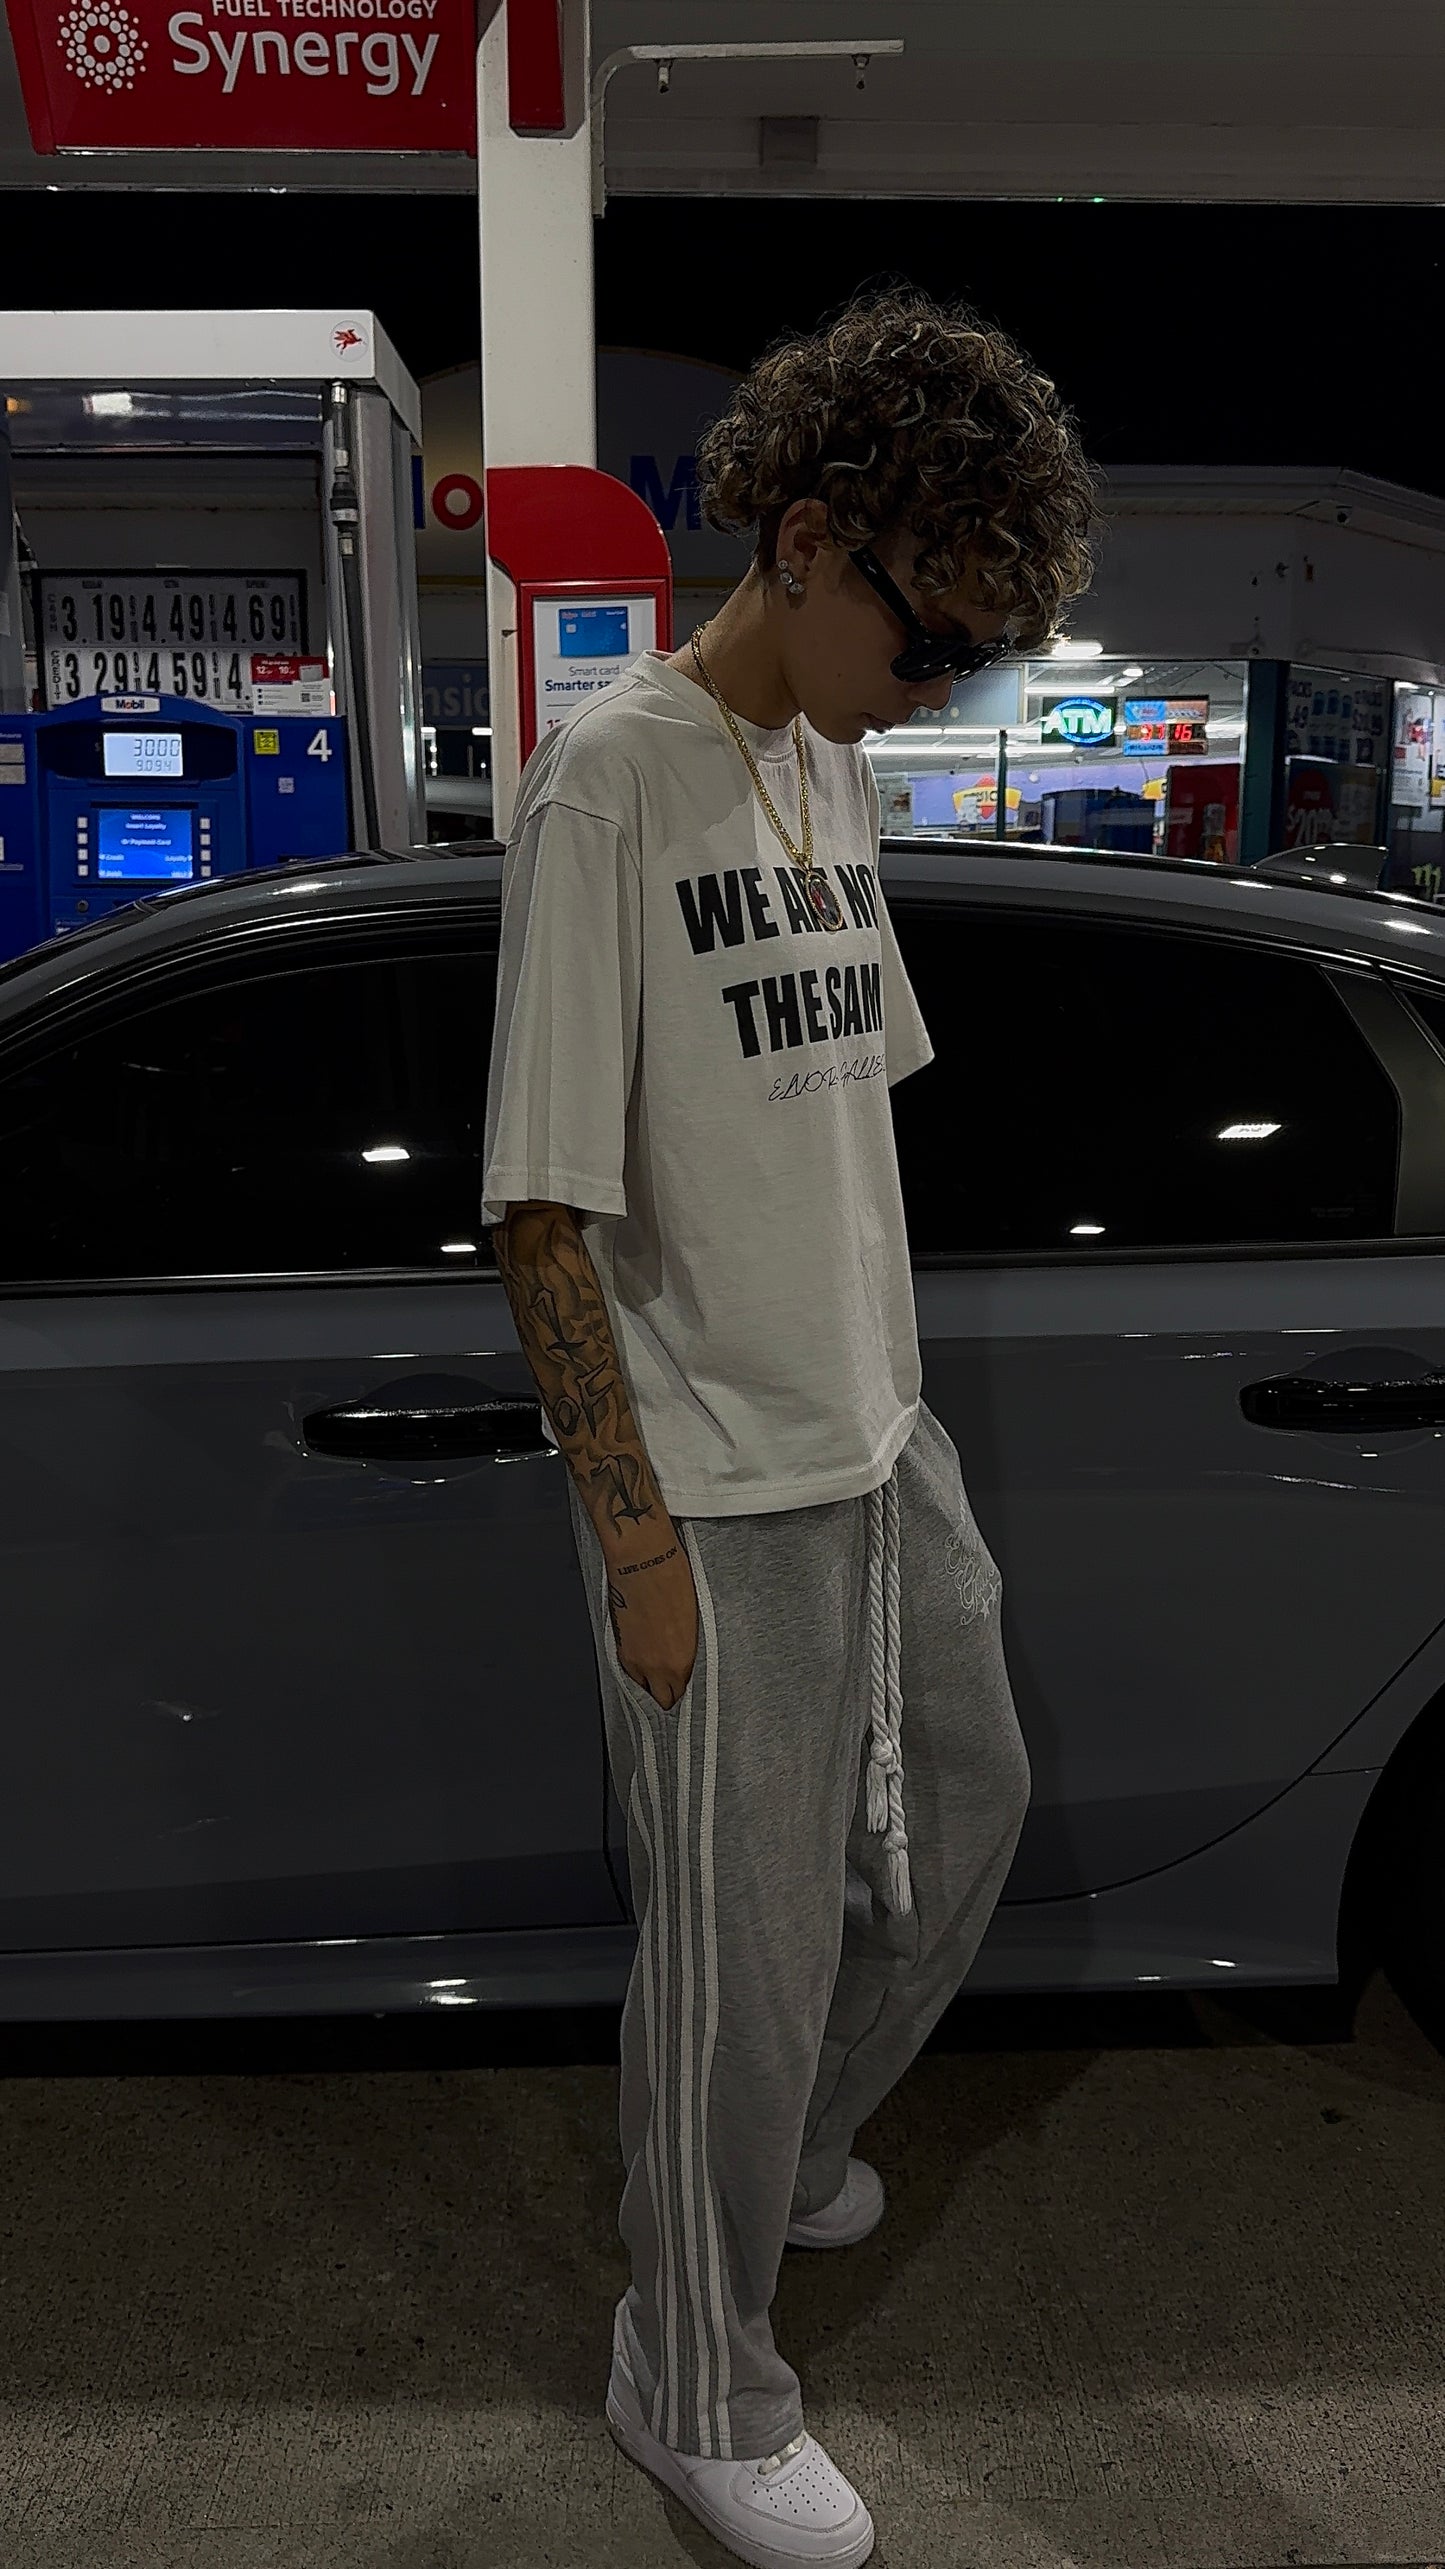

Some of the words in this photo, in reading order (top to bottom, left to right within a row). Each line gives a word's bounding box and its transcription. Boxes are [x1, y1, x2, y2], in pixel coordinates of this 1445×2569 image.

[213, 0, 272, 17] FUEL
[277, 0, 438, 19] TECHNOLOGY
[167, 10, 440, 95] Synergy
[568, 666, 598, 677] Smart
[599, 664, 620, 675] card
[545, 679, 595, 691] Smarter
[116, 699, 145, 709] Mobil
[1042, 708, 1112, 734] ATM
[307, 729, 333, 762] 4
[675, 868, 781, 956] WE
[616, 1564, 640, 1576] LIFE
[639, 1554, 666, 1570] GOES
[665, 1546, 678, 1559] ON
